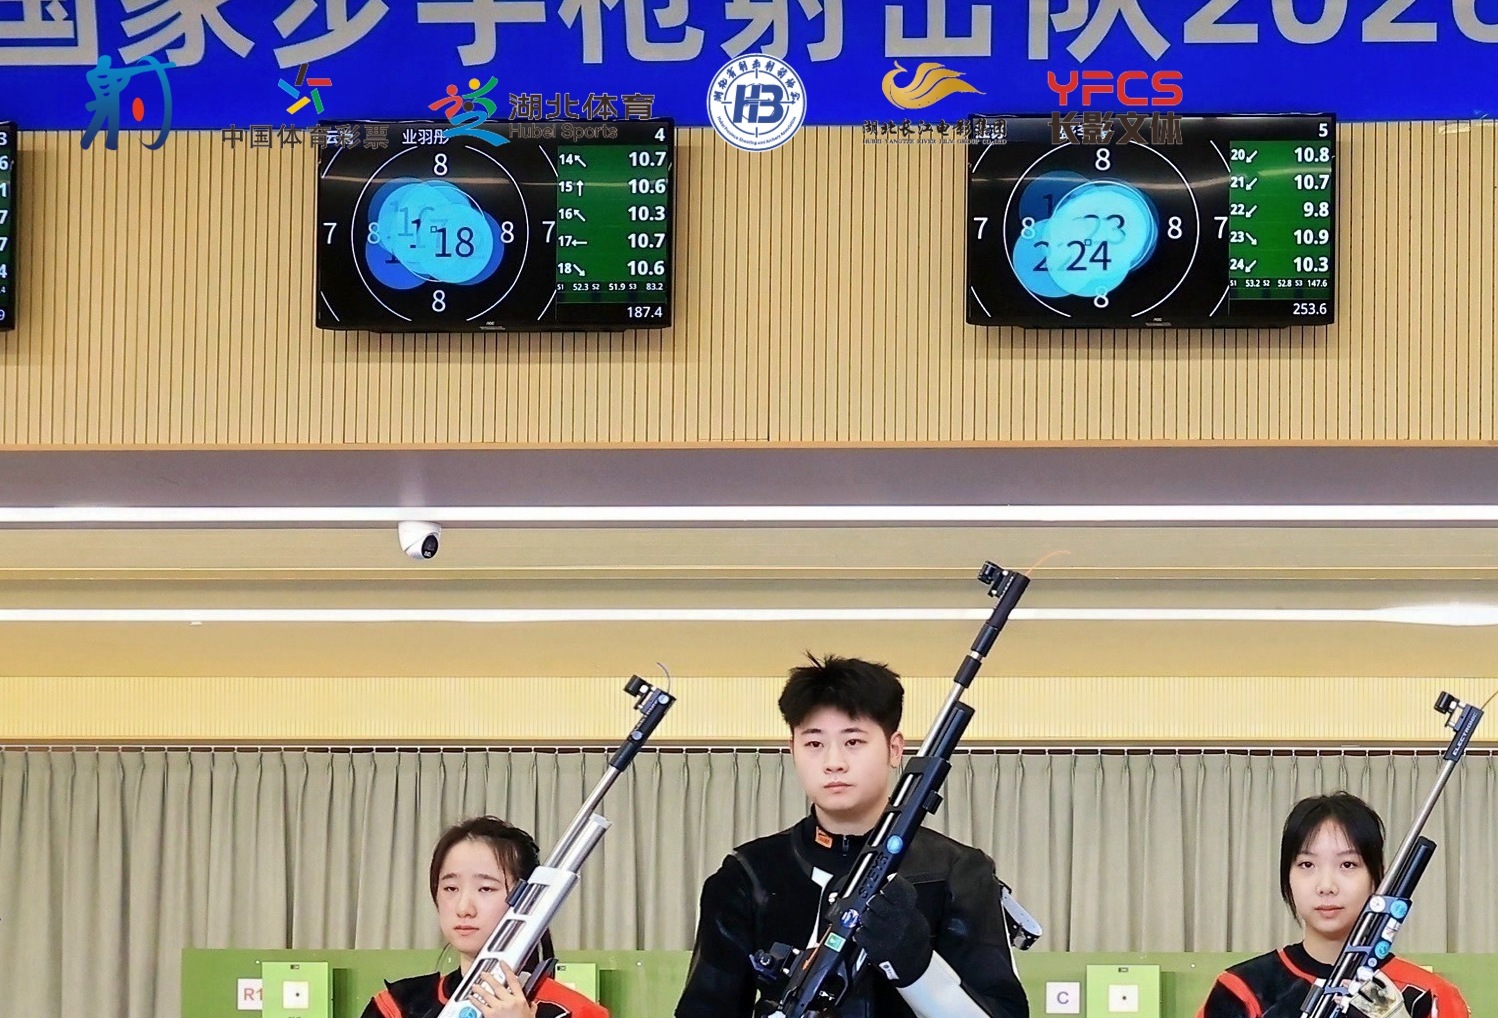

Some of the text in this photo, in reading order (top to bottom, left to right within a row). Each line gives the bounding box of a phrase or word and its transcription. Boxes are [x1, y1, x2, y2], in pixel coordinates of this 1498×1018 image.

[654, 128, 665, 141] 4
[1318, 123, 1328, 138] 5
[559, 152, 666, 167] 14 10.7
[1095, 148, 1111, 171] 8
[1230, 147, 1330, 162] 20 10.8
[433, 153, 448, 176] 8
[558, 179, 666, 194] 15 10.6
[1230, 175, 1330, 189] 21 10.7
[558, 206, 666, 221] 16 10.3
[1230, 202, 1329, 217] 22 9.8
[323, 222, 337, 244] 7
[367, 222, 380, 244] 8
[500, 221, 515, 244] 8
[542, 221, 556, 243] 7
[974, 217, 988, 239] 7
[1021, 217, 1035, 239] 8
[1168, 216, 1183, 239] 8
[1214, 217, 1228, 238] 7
[435, 227, 475, 258] 18
[558, 233, 665, 248] 17 10.7
[1230, 230, 1329, 245] 23 10.9
[1066, 240, 1112, 272] 24
[558, 260, 665, 275] 18 10.6
[1229, 257, 1329, 272] 24 10.3
[573, 283, 664, 291] 52.3 51.9 83.2
[432, 290, 446, 312] 8
[1094, 286, 1109, 308] 8
[627, 307, 663, 318] 187.4
[1292, 303, 1327, 315] 253.6
[1057, 991, 1069, 1005] C
